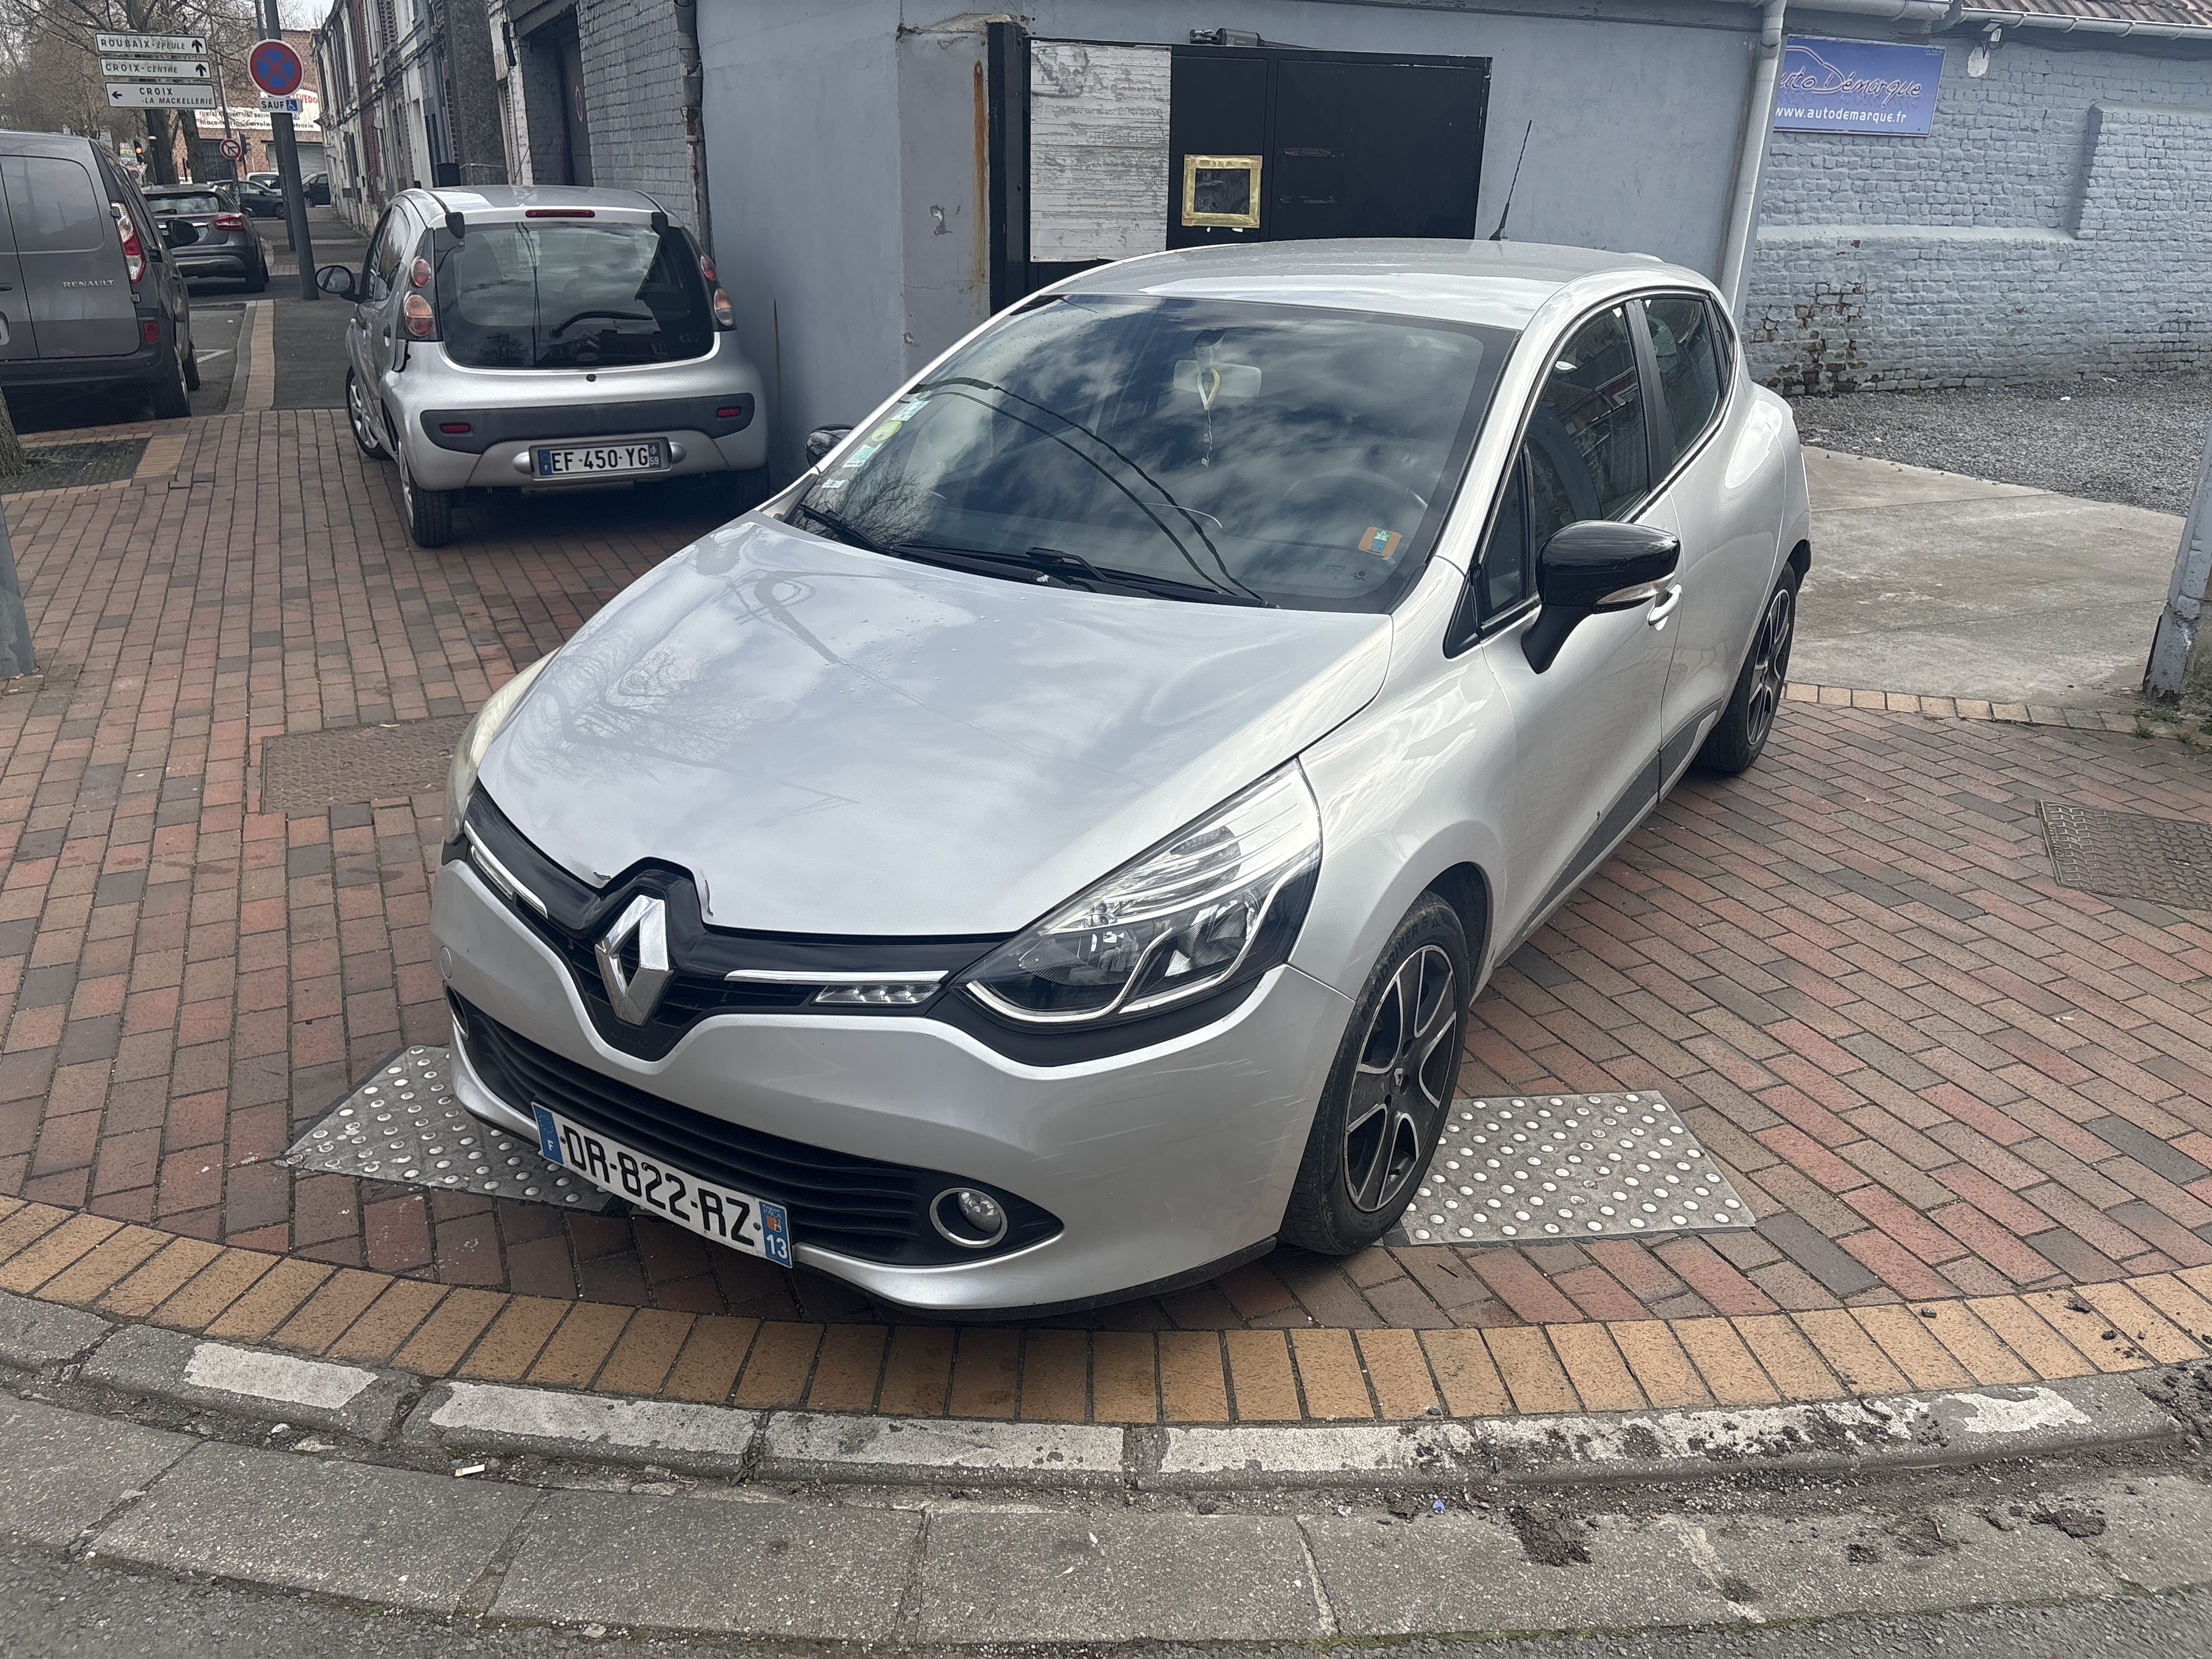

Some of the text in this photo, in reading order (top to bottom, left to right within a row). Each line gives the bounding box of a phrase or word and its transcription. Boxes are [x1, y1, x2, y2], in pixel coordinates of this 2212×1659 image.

[1780, 63, 1921, 106] uto Démarque
[139, 87, 173, 96] CROIX
[261, 100, 284, 109] SAUF
[63, 279, 115, 288] RENAULT
[551, 447, 648, 472] EF-450-YG
[650, 456, 659, 465] 59
[547, 1139, 554, 1152] F
[563, 1125, 755, 1246] DR-822-RZ
[766, 1234, 788, 1259] 13
